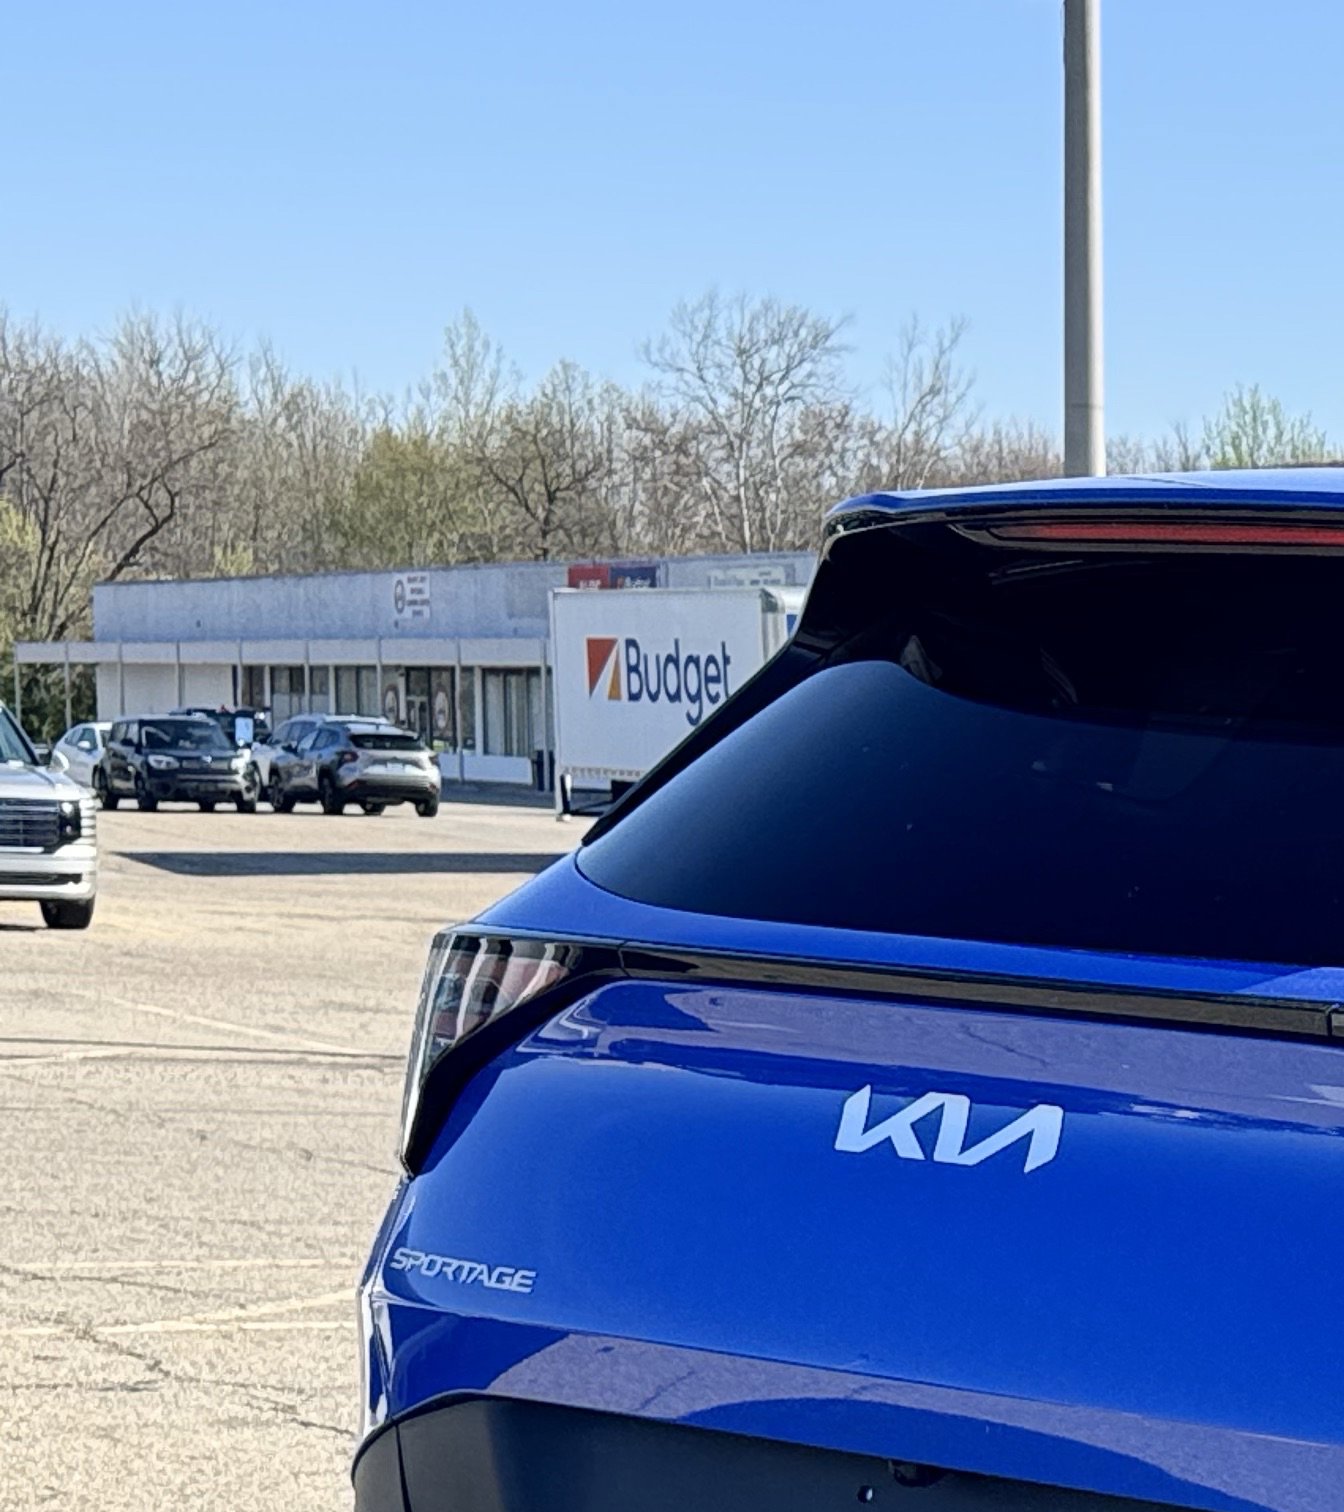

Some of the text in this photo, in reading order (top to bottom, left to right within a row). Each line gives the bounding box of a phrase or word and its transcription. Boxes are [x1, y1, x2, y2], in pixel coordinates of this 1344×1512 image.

[625, 638, 731, 726] Budget
[834, 1084, 1064, 1173] KIA
[390, 1247, 536, 1294] SPORTAGE
